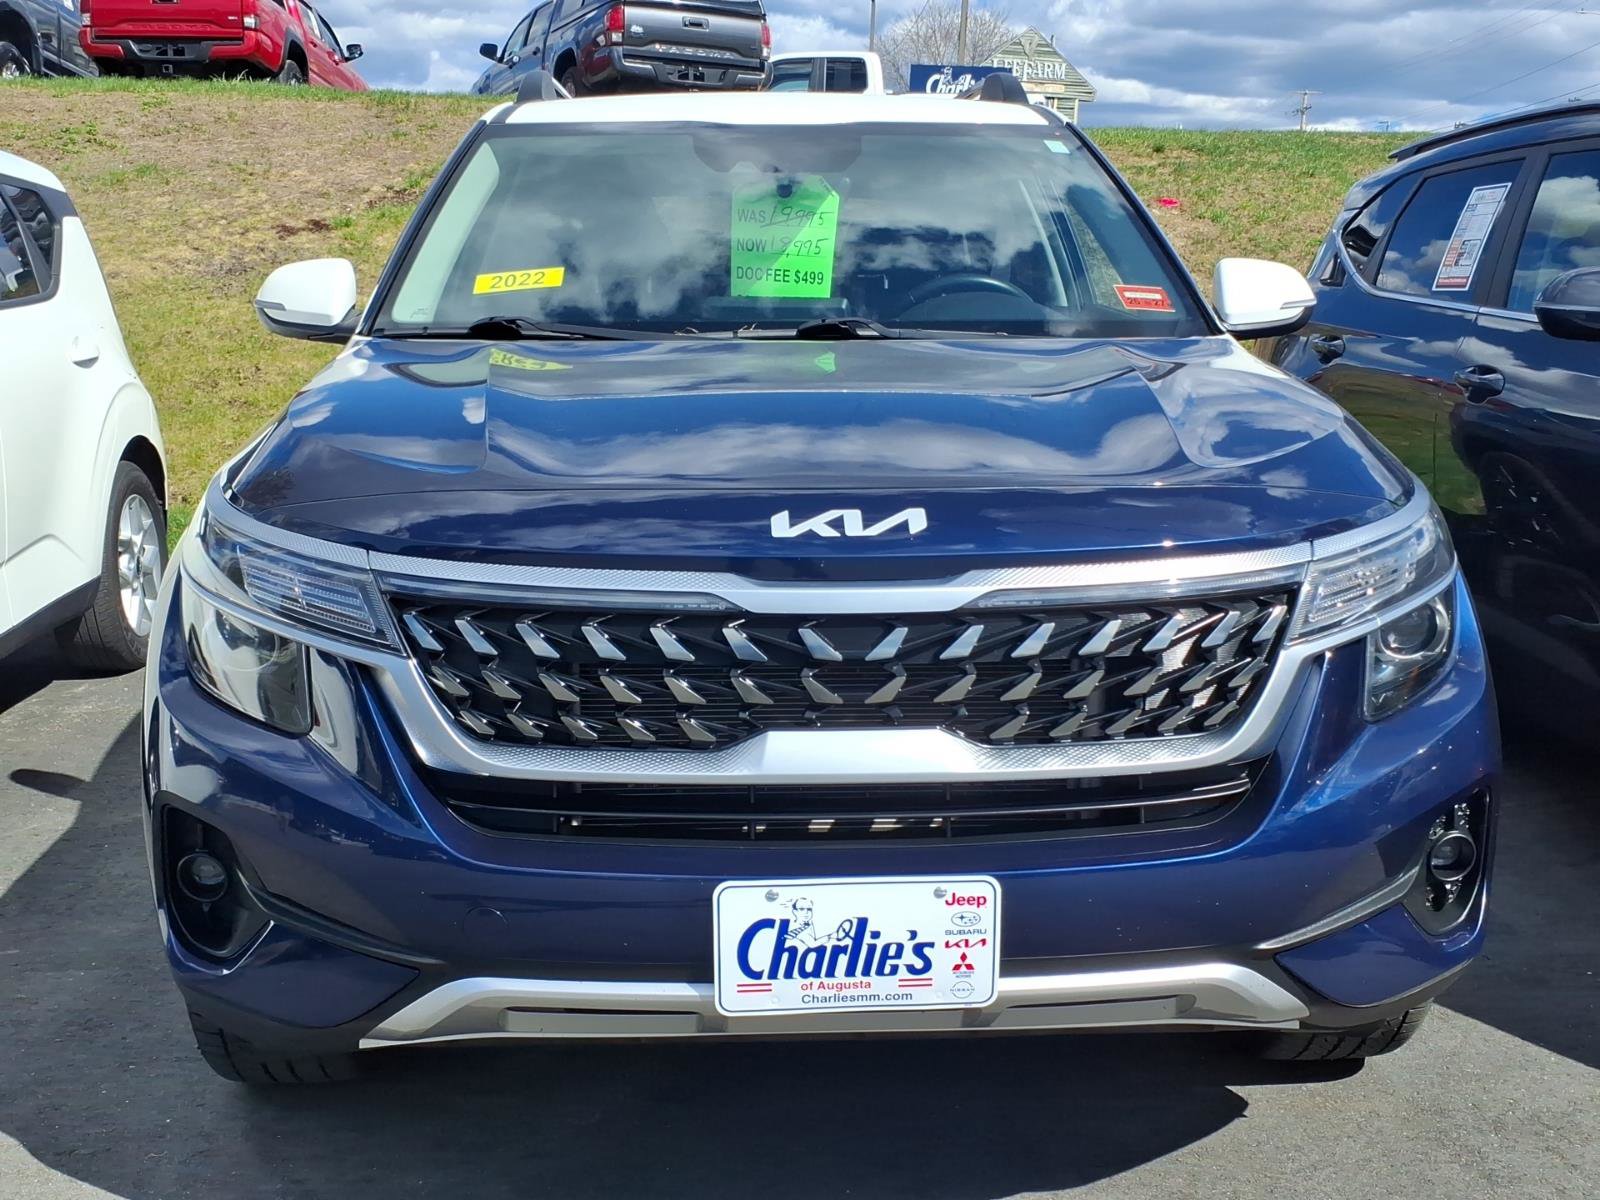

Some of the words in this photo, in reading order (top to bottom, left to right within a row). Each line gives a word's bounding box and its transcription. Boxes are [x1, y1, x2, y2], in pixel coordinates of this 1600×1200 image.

[926, 73, 976, 94] Charl
[737, 209, 767, 223] WAS
[736, 239, 767, 252] NOW
[489, 271, 546, 289] 2022
[736, 266, 764, 281] DOC
[765, 268, 791, 283] FEE
[794, 269, 825, 286] $499
[770, 507, 928, 538] KIA
[945, 892, 988, 908] Jeep
[944, 928, 988, 936] SUBARU
[737, 917, 935, 980] Charlie's
[944, 938, 988, 949] KIA
[800, 980, 815, 992] of
[817, 979, 872, 993] Augusta
[800, 992, 914, 1005] Charliesmm.com
